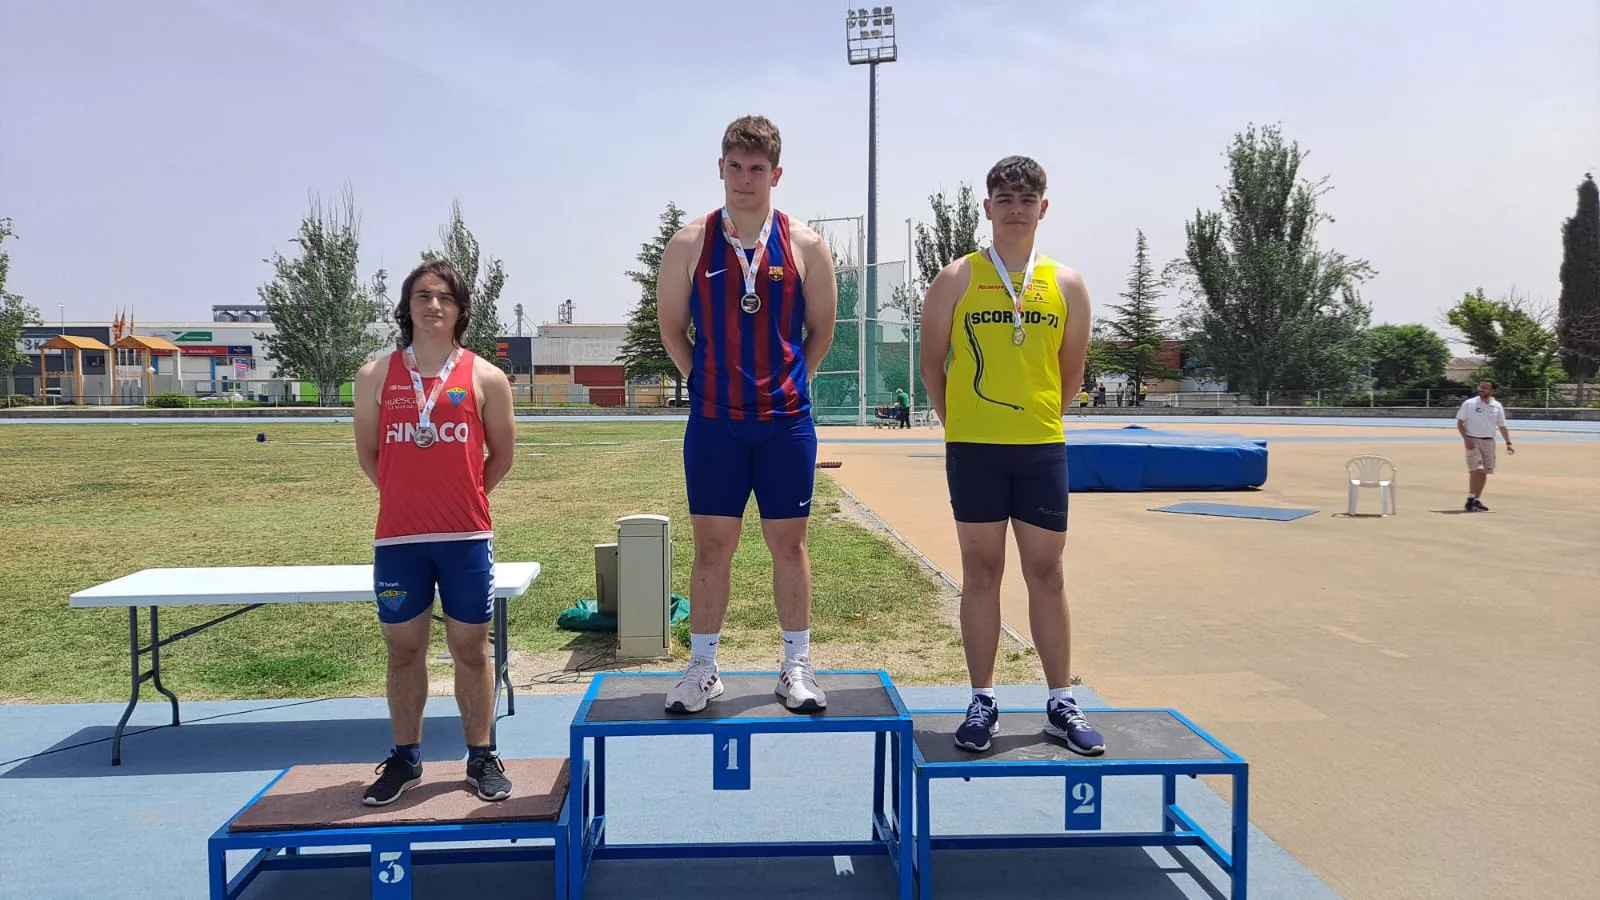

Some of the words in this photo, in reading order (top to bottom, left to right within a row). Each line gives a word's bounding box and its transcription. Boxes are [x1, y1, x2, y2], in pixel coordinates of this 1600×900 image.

[722, 738, 740, 770] 1
[1072, 782, 1095, 814] 2
[378, 851, 405, 884] 3
